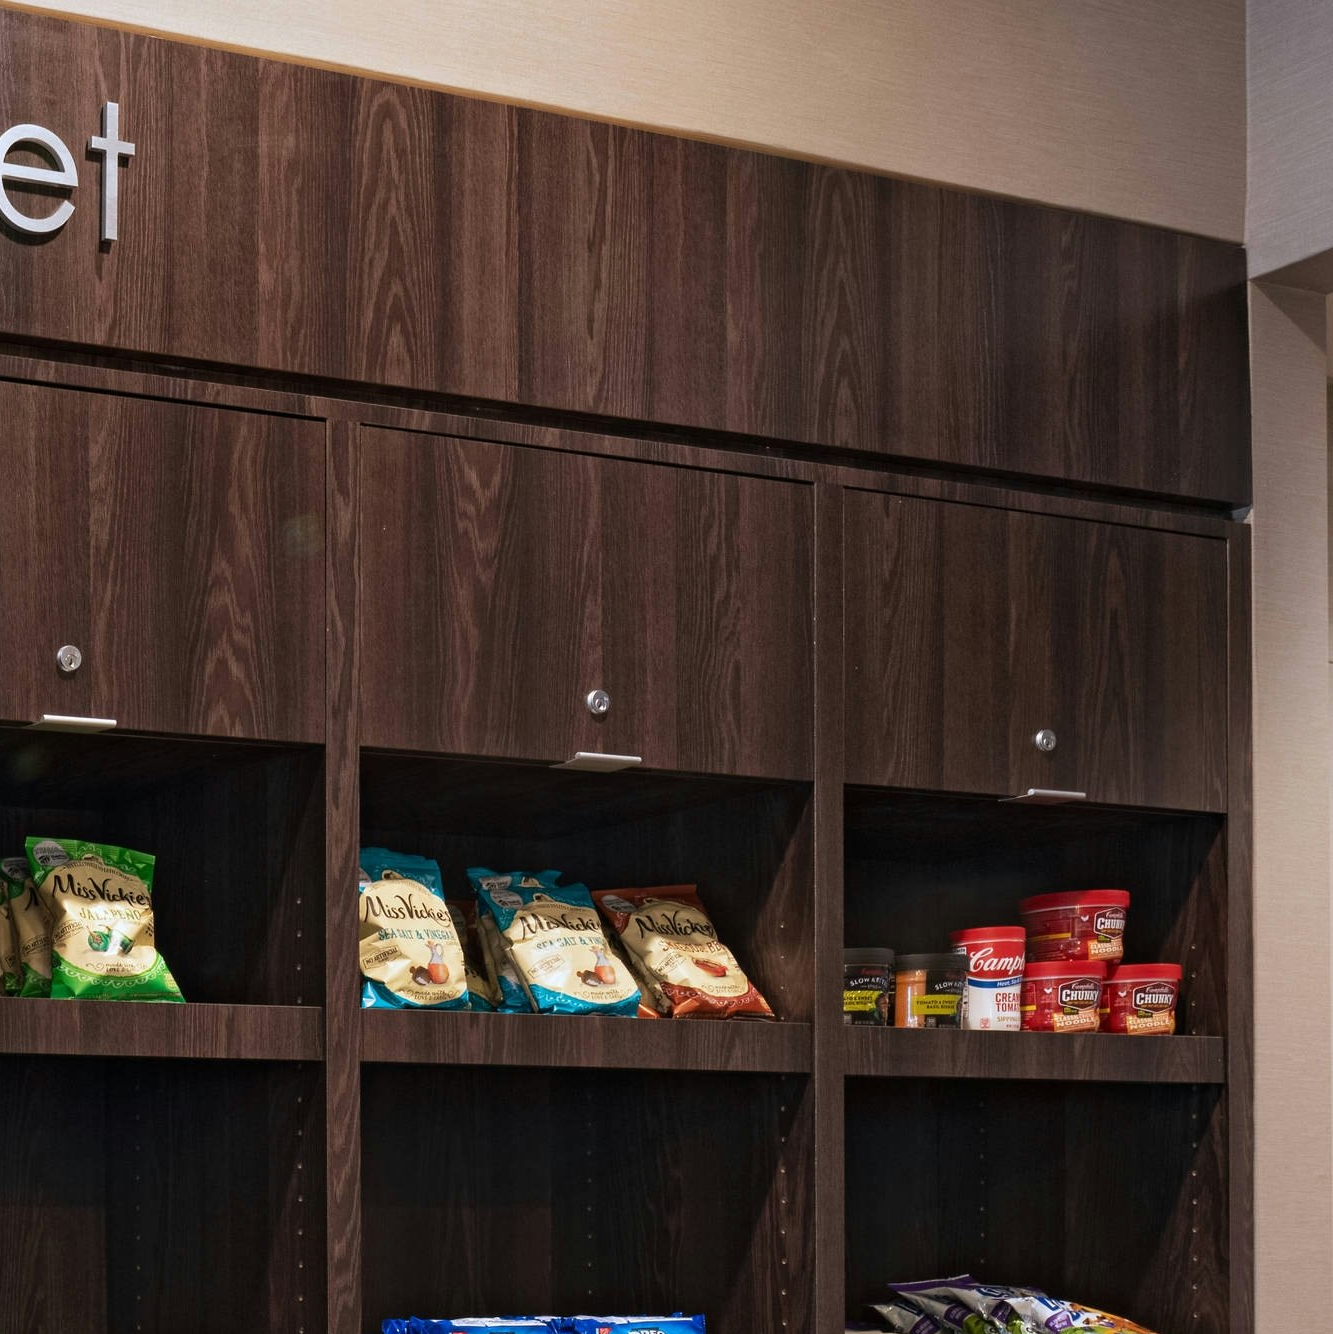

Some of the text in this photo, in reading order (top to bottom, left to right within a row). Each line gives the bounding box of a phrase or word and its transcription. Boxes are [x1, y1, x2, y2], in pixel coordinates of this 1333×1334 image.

[52, 874, 96, 900] Miss
[364, 895, 406, 923] Miss
[378, 928, 414, 941] SEA SALT
[558, 936, 576, 948] SALT
[849, 976, 870, 987] SLOW
[934, 982, 953, 991] SLOW
[1061, 989, 1099, 1002] CHUNKY
[1135, 991, 1174, 1006] CHUNKY
[1056, 1017, 1096, 1027] NOODLE
[1130, 1020, 1171, 1030] NOODLE
